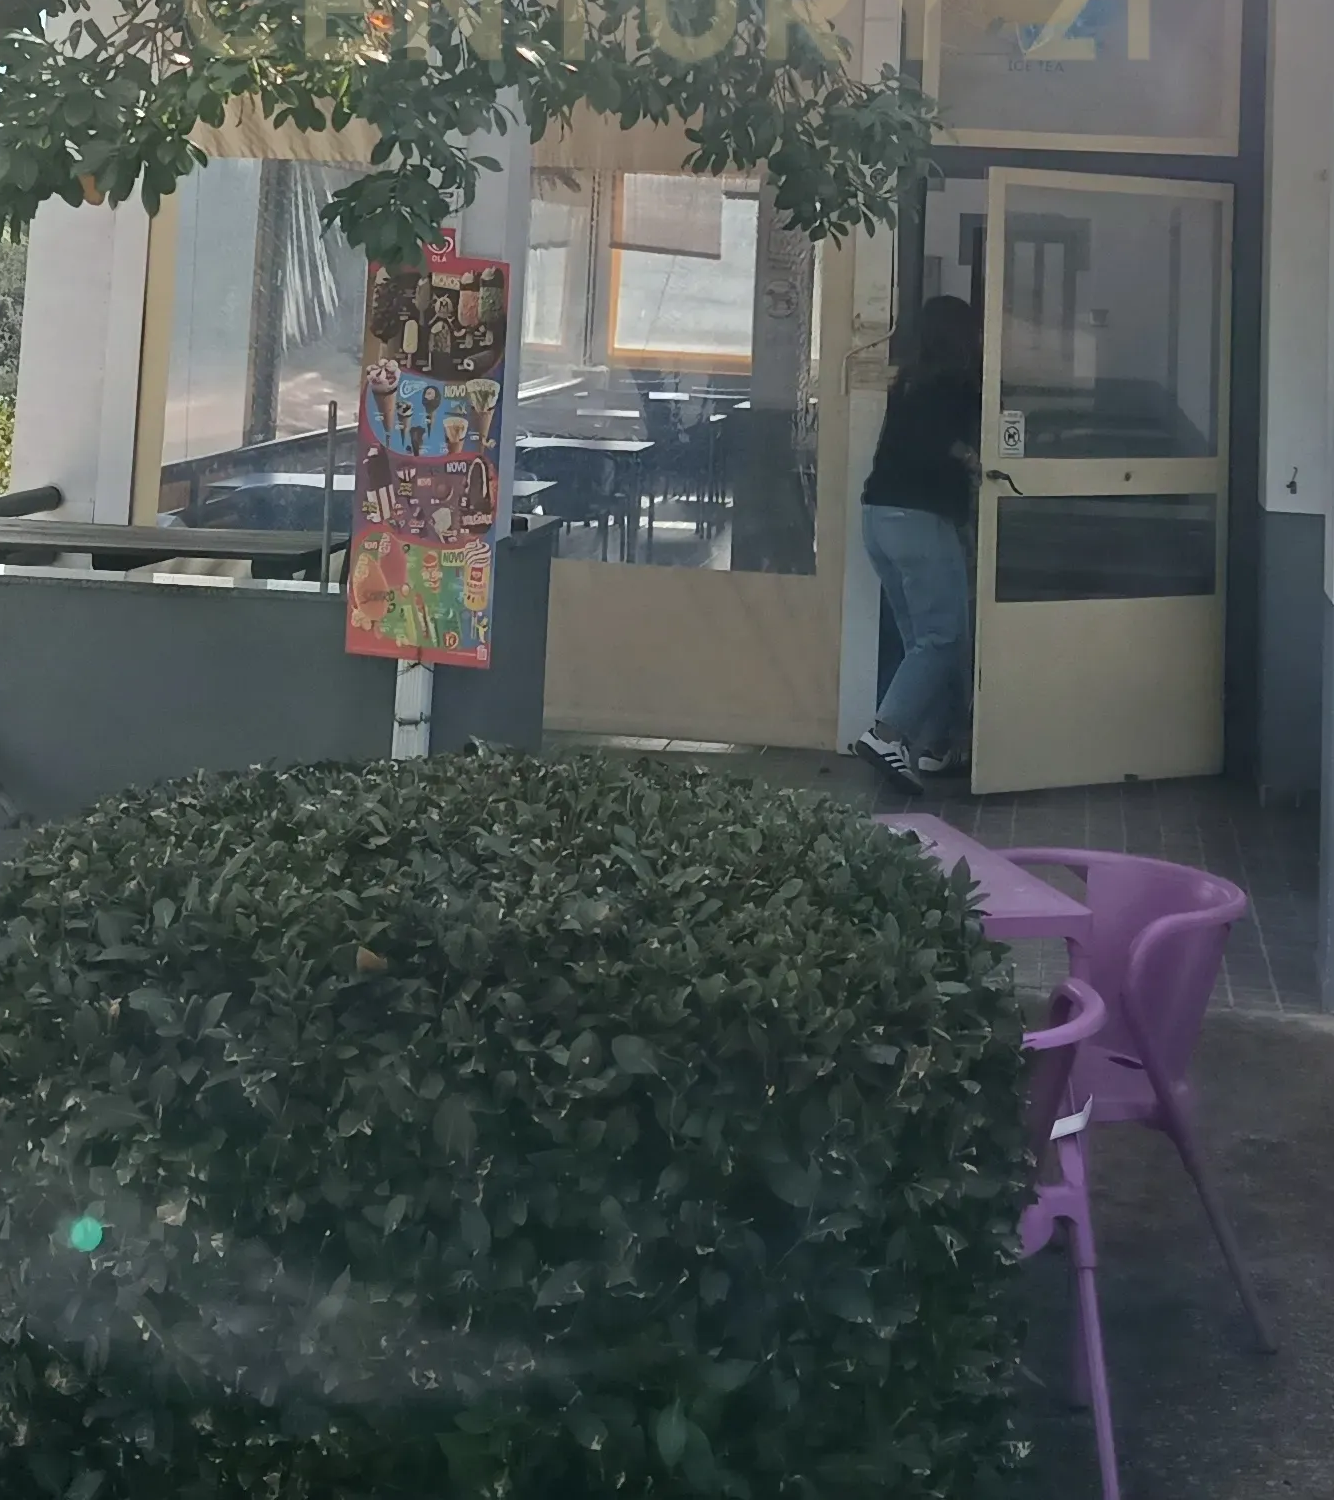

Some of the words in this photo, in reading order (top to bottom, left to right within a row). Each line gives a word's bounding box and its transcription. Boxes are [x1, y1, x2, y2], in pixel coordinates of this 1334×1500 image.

[1007, 60, 1032, 72] ICE
[1038, 60, 1065, 73] TEA
[431, 254, 447, 263] OLÁ
[444, 384, 466, 398] NOVO
[446, 461, 467, 473] NOVO
[443, 550, 465, 564] NOVO
